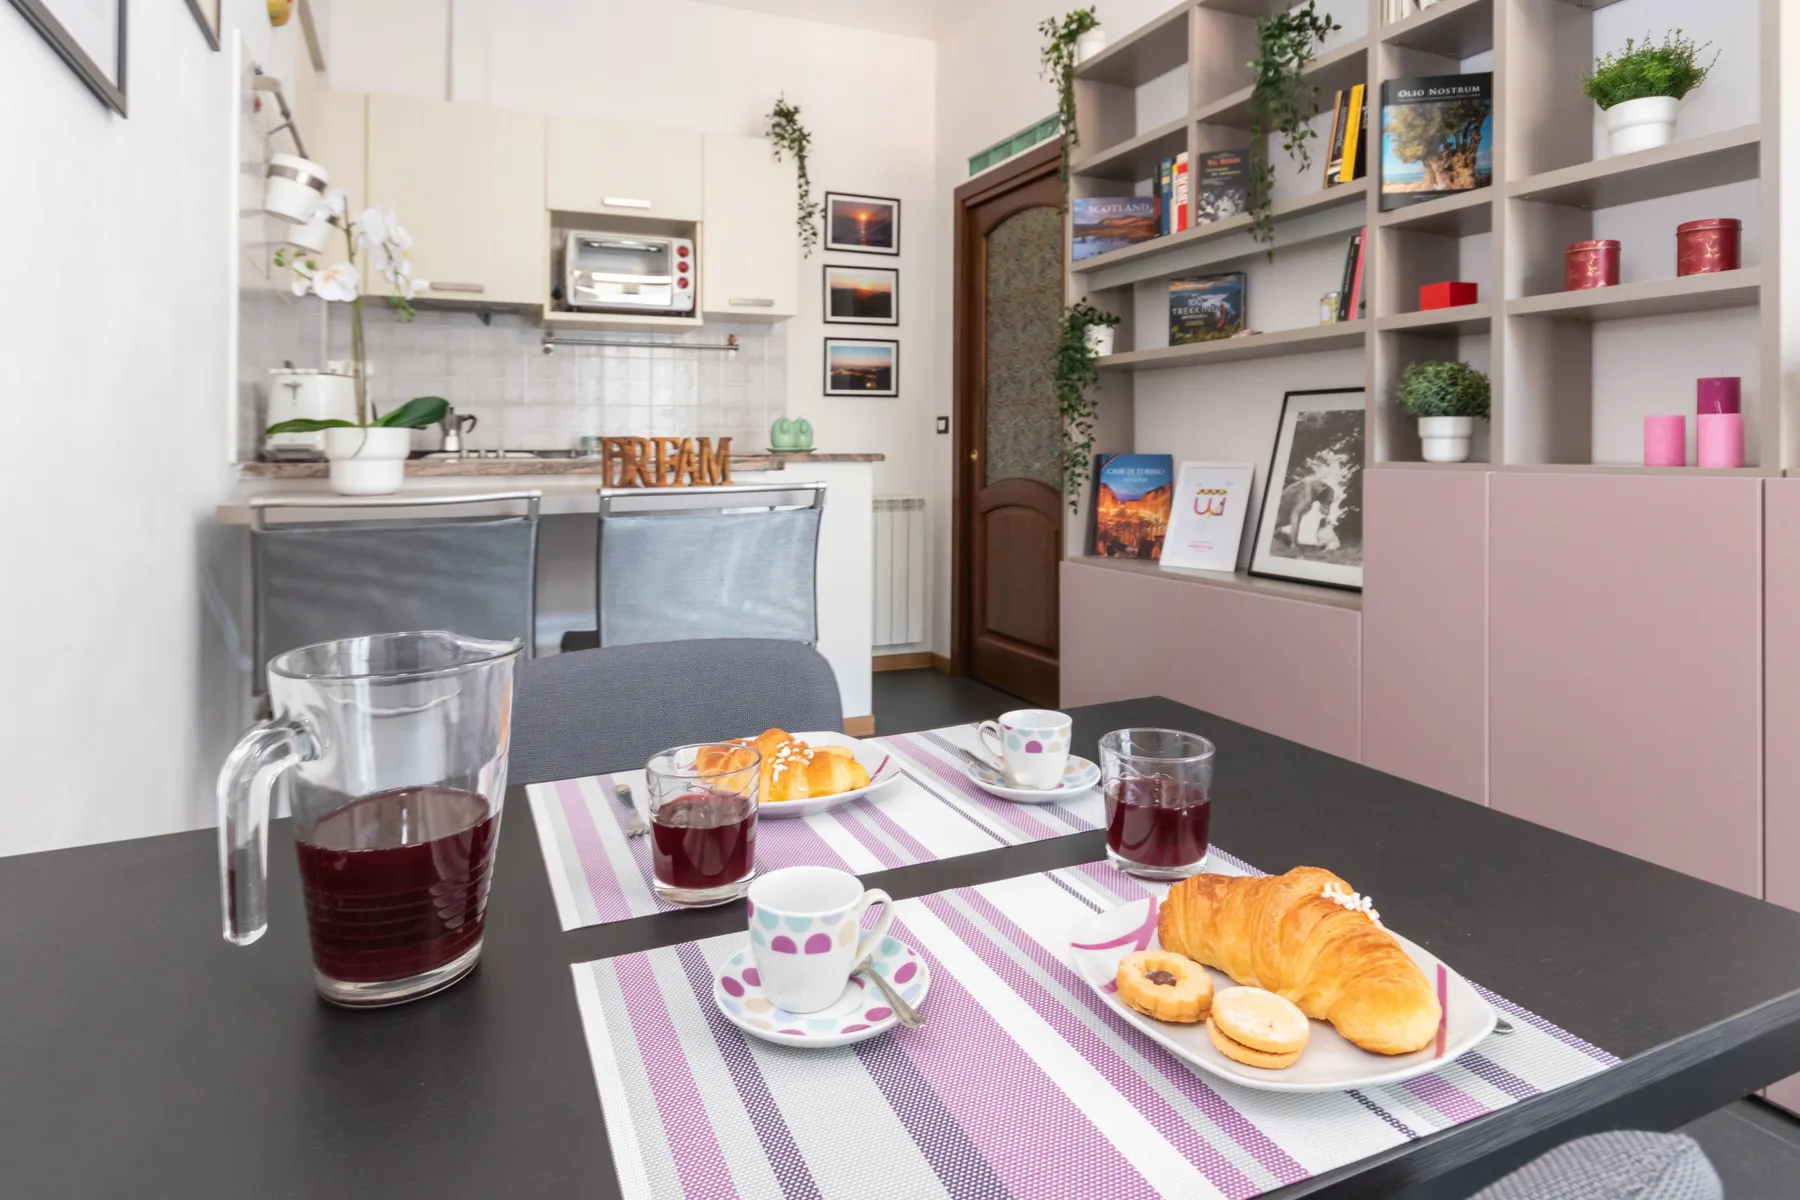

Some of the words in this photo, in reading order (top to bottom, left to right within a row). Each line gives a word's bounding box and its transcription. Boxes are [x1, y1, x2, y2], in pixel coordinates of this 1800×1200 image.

[1397, 90, 1425, 98] OLIO
[1429, 86, 1481, 95] NOSTRUM
[1088, 203, 1150, 214] SCOTLAND
[1172, 305, 1219, 315] TREKKING
